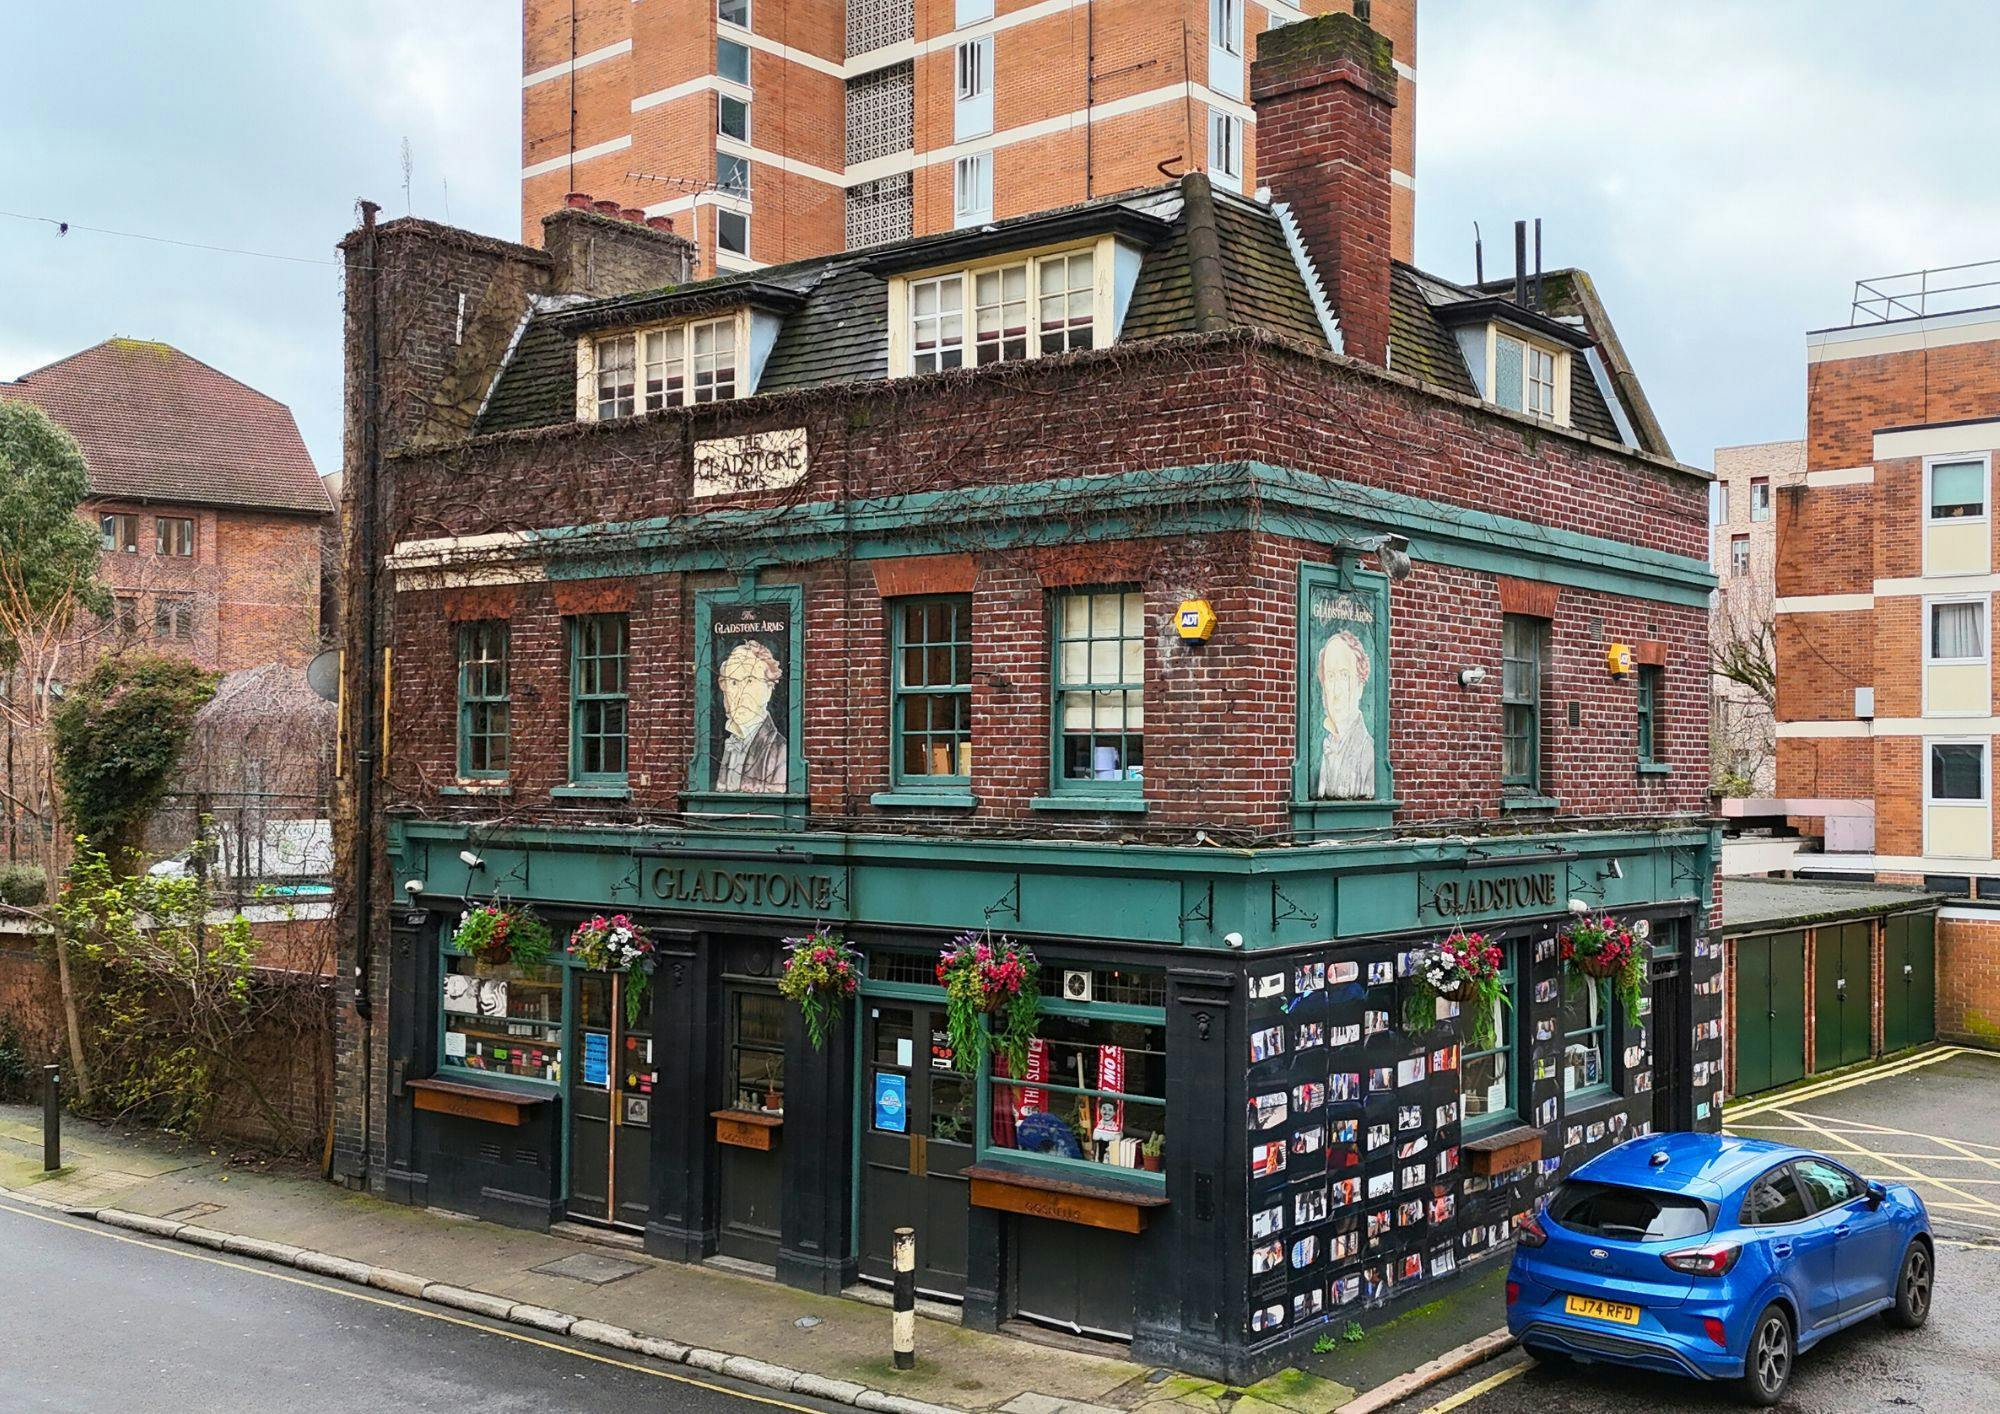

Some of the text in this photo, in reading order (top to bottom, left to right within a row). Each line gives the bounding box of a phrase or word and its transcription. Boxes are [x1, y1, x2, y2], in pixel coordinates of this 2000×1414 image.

[737, 436, 761, 452] THE
[697, 446, 802, 480] GLADSTONE
[734, 475, 768, 492] ARMS
[1182, 613, 1198, 626] ADT
[652, 866, 832, 910] GLADSTONE
[1435, 873, 1557, 917] GLADSTONE
[1026, 1051, 1040, 1081] SLOT
[1103, 1057, 1116, 1086] MO
[1570, 1298, 1633, 1320] LJ74 RFD
